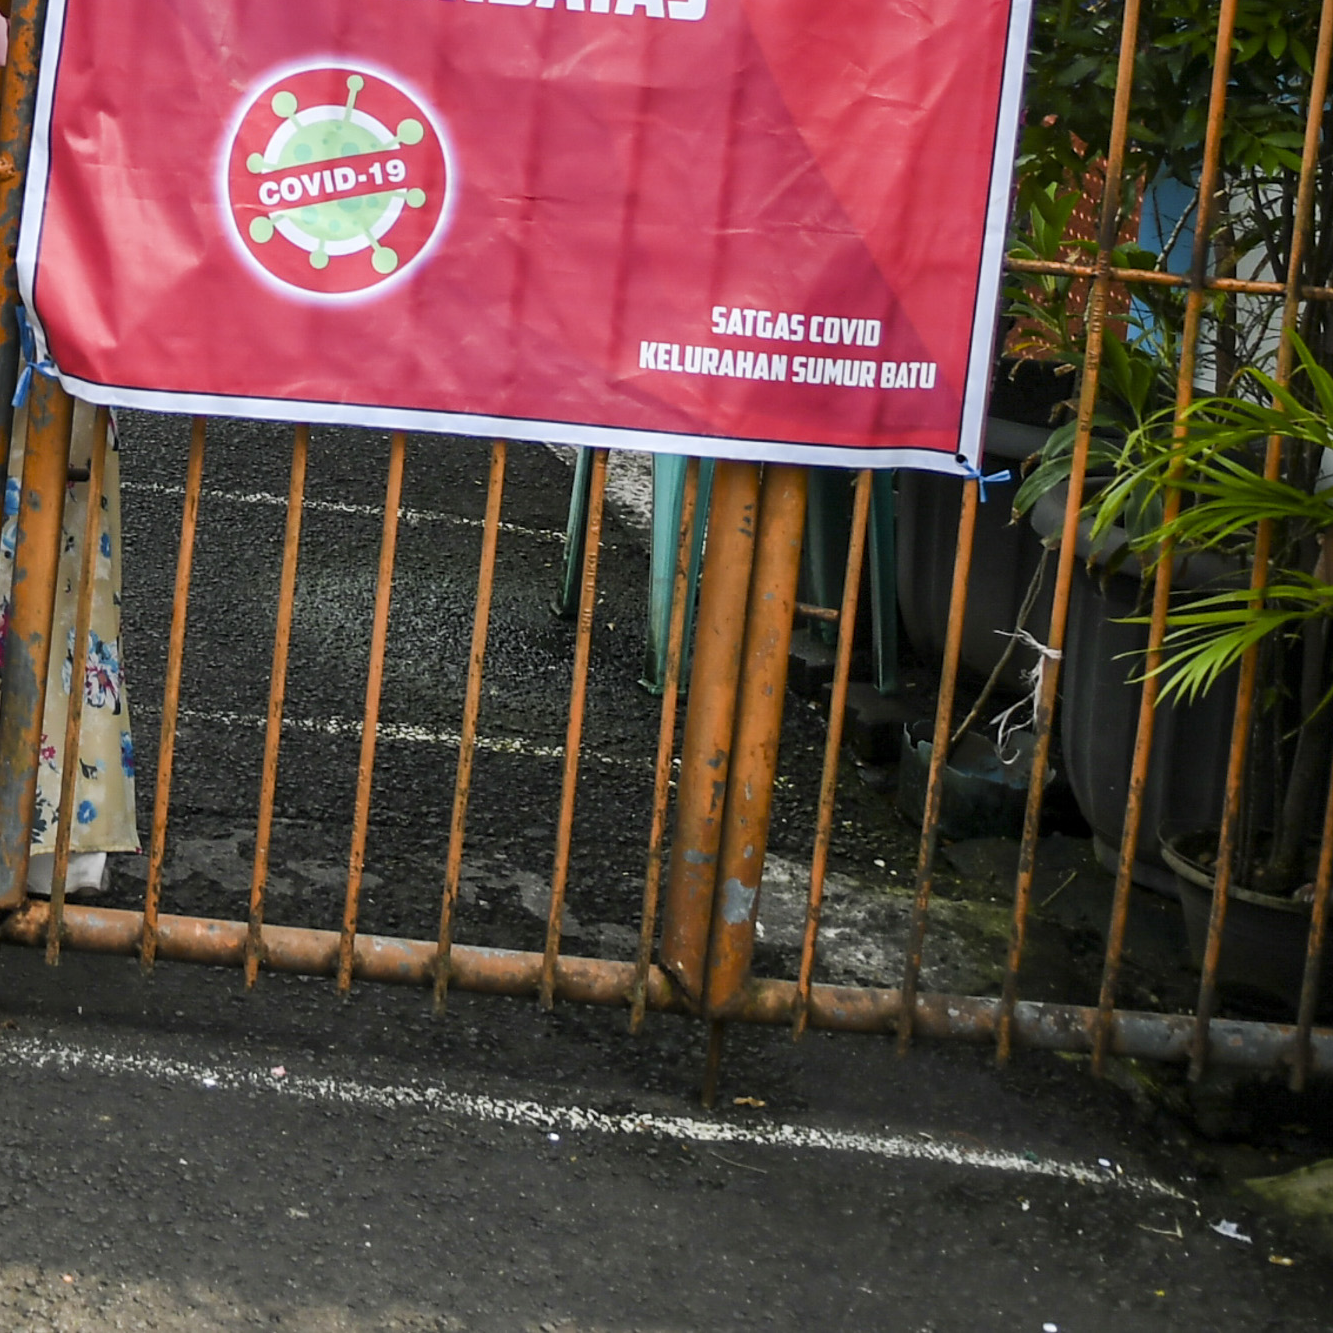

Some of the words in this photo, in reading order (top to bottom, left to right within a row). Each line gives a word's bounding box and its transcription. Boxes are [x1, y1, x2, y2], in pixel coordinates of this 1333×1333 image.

[258, 159, 406, 205] COVID-19
[711, 306, 805, 342] SATGAS
[808, 315, 881, 347] COVID
[639, 340, 787, 381] KELURAHAN
[792, 355, 875, 387] SUMUR
[880, 361, 937, 389] BATU
